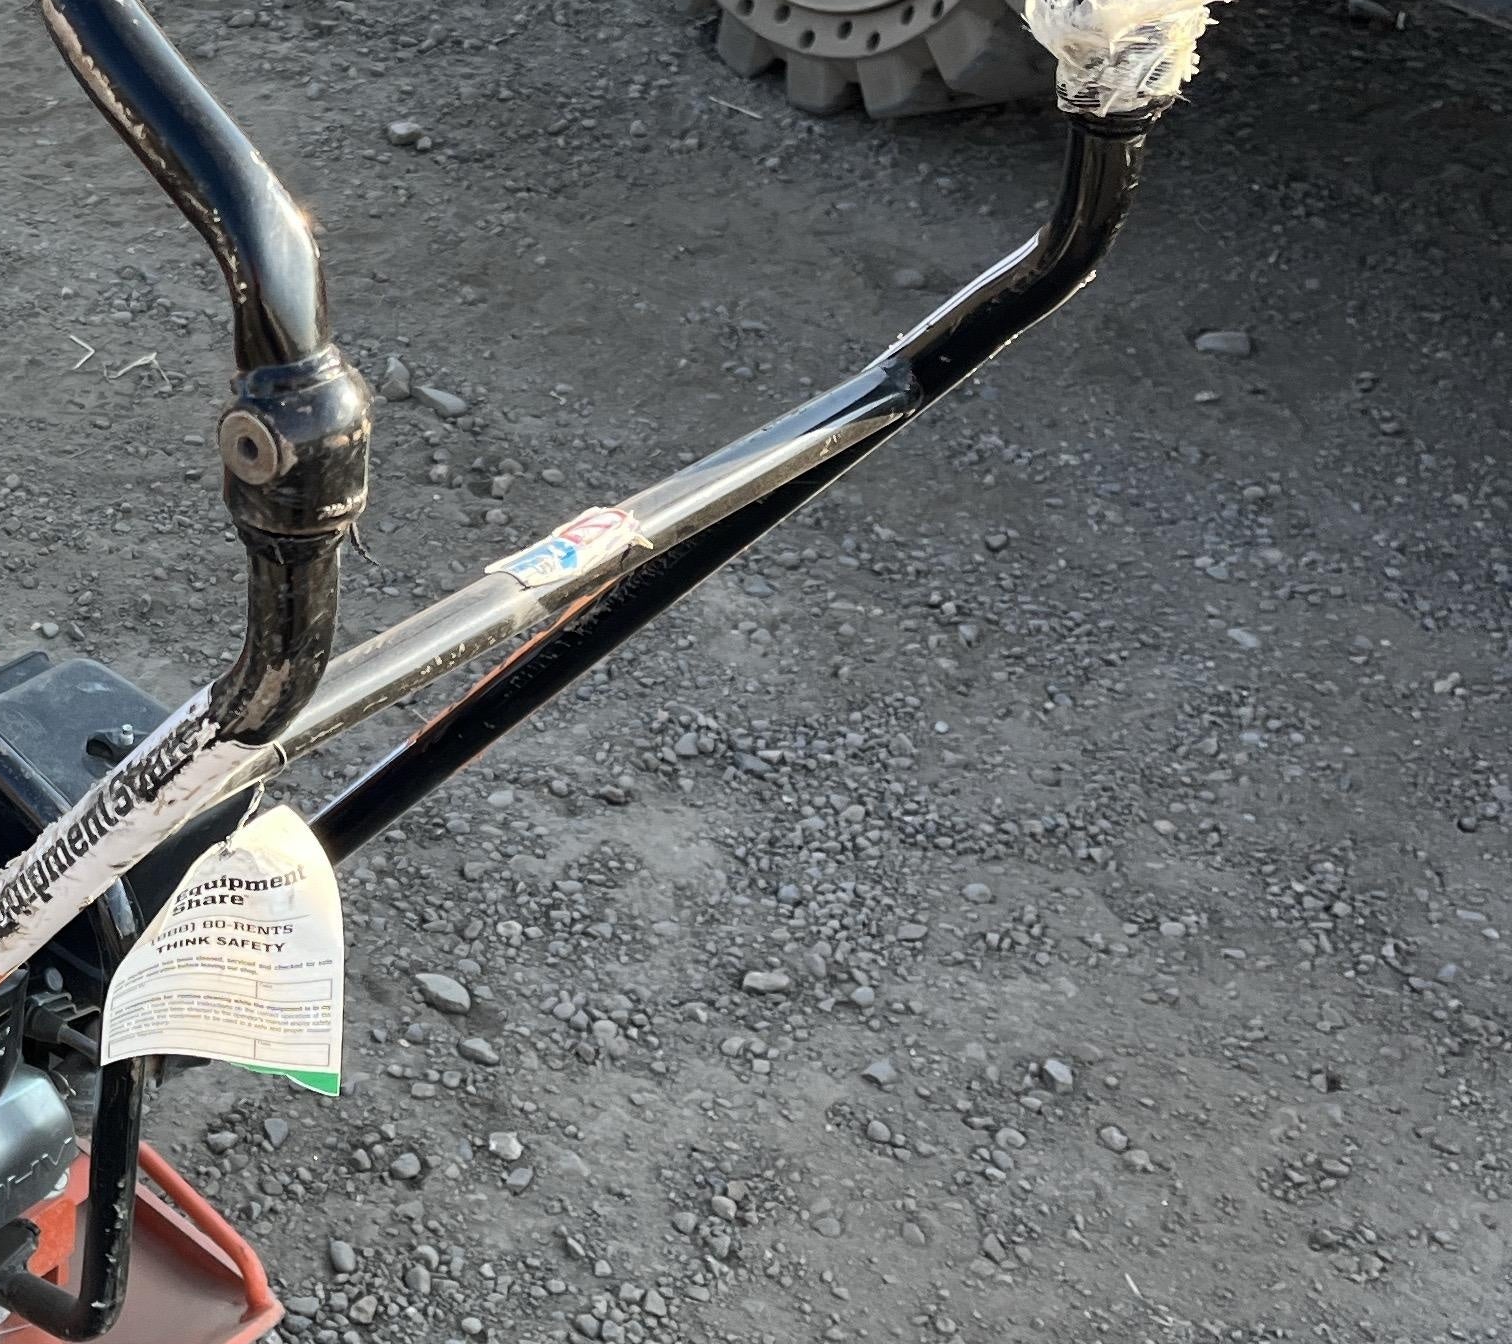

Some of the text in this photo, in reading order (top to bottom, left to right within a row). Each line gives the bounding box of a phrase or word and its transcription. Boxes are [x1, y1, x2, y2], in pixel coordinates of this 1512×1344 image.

[175, 864, 311, 905] Equipment
[171, 893, 245, 916] Share
[156, 936, 287, 954] THINK SAFETY
